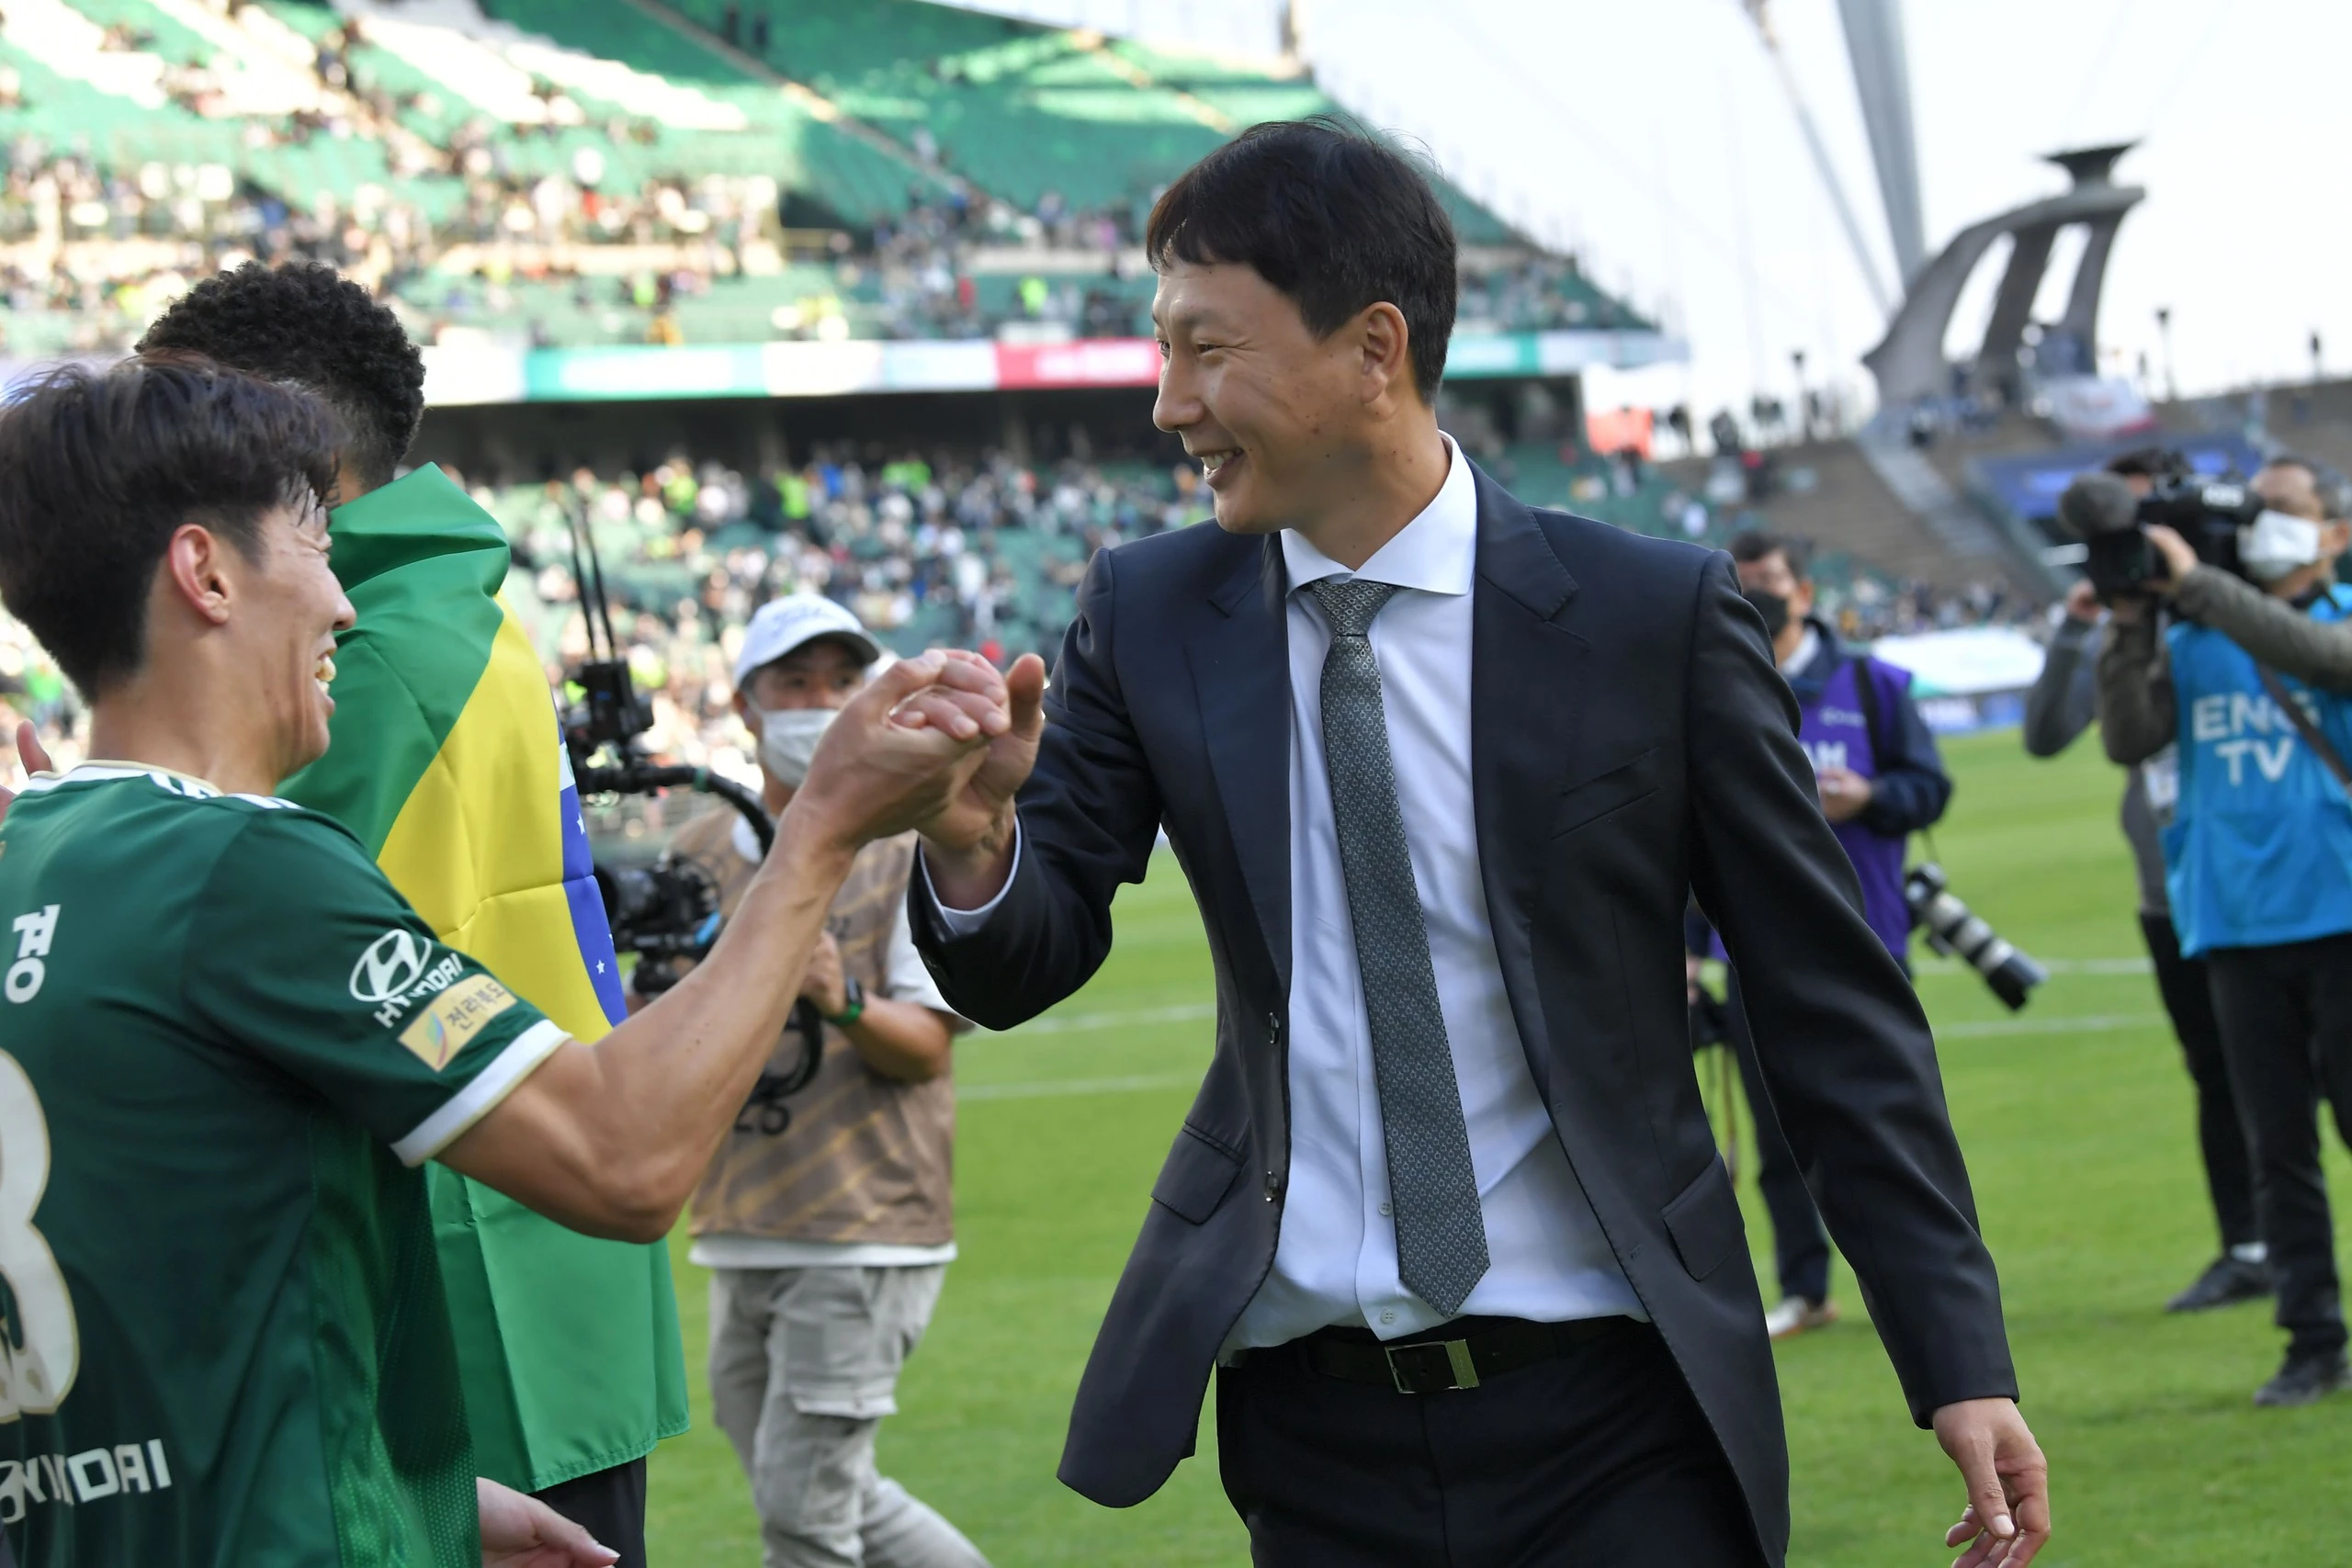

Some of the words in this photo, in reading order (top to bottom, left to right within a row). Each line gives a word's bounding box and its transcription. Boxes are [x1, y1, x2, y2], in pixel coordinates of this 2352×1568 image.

[2215, 735, 2294, 786] TV
[373, 952, 463, 1030] HYNDAI
[446, 982, 505, 1032] 전라북도
